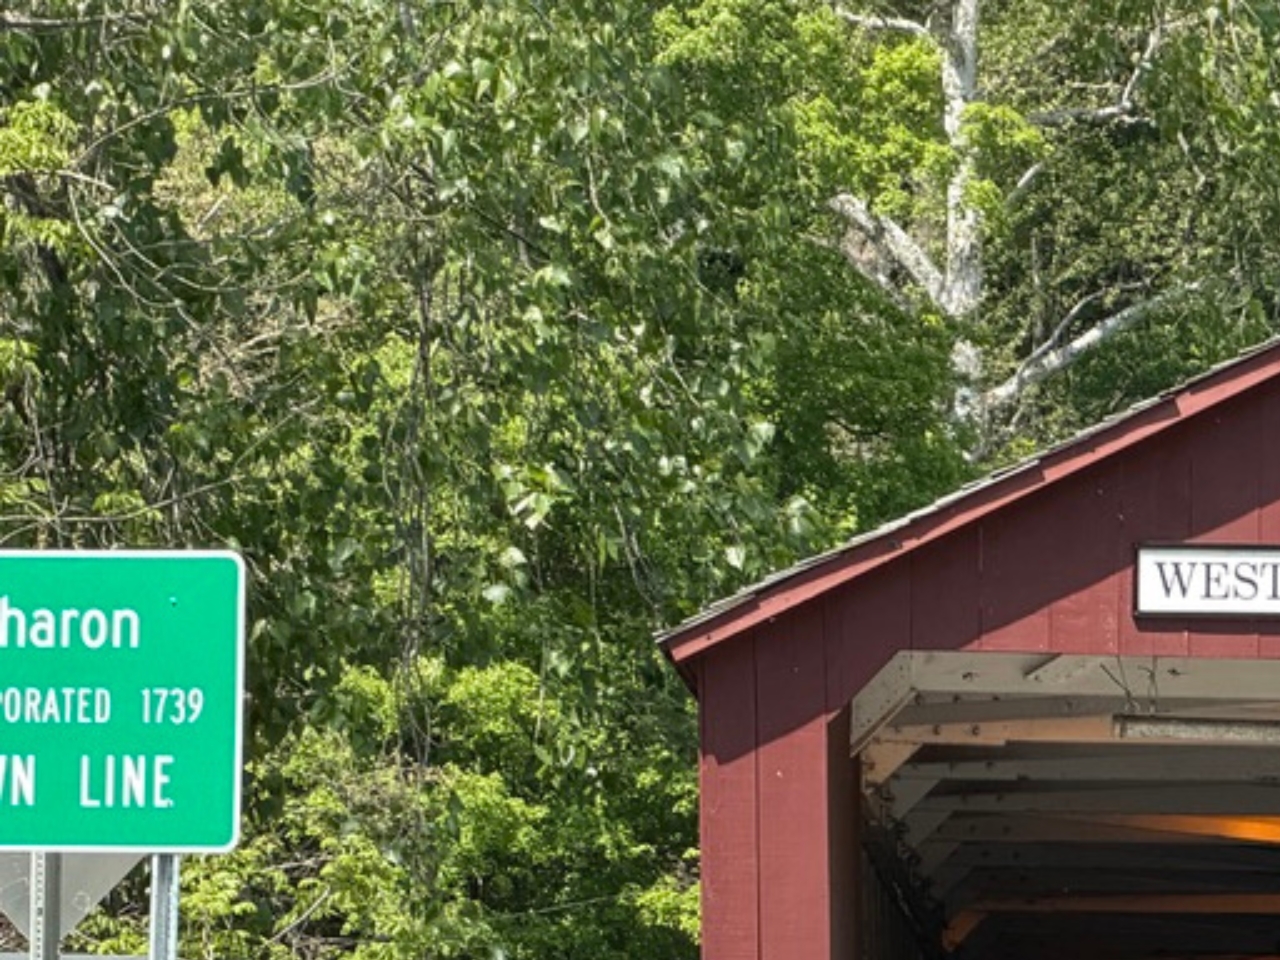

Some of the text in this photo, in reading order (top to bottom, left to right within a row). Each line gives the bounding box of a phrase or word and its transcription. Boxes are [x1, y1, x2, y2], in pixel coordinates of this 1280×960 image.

[0, 686, 204, 725] ORATED 1739
[80, 754, 174, 808] LINE
